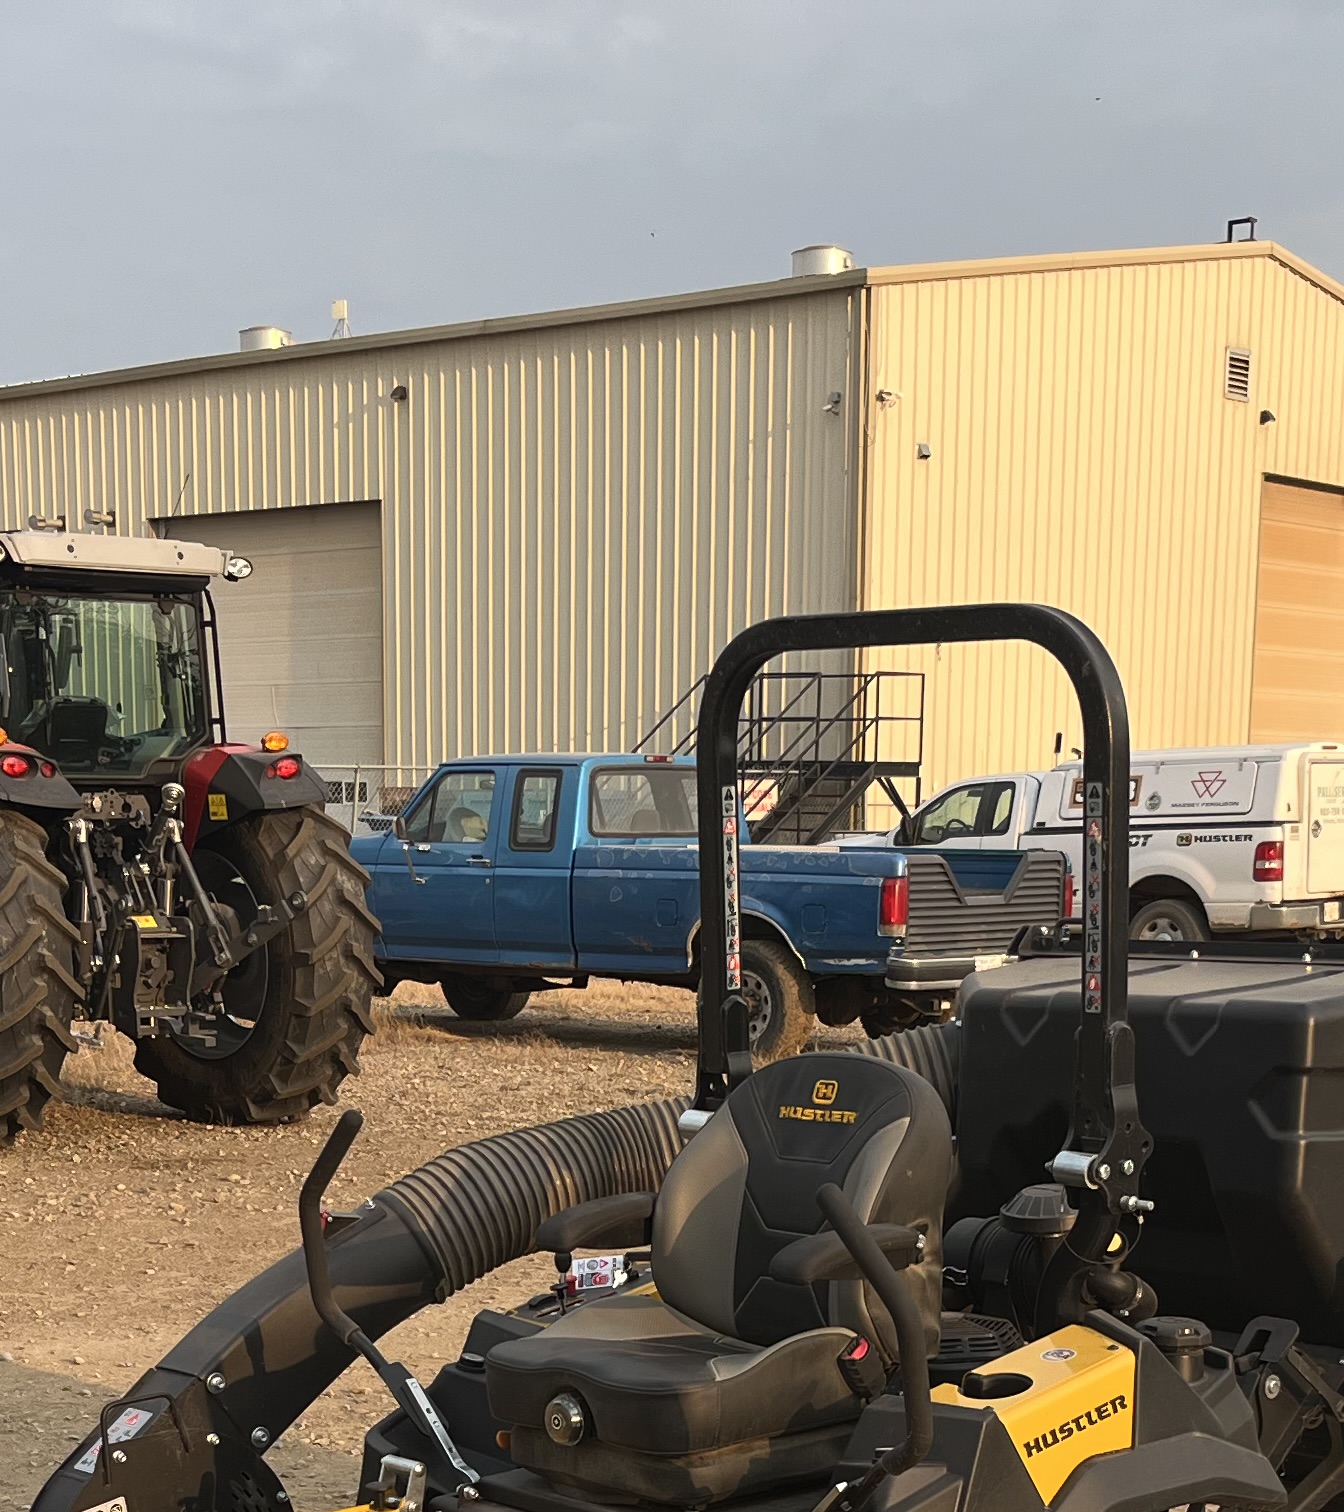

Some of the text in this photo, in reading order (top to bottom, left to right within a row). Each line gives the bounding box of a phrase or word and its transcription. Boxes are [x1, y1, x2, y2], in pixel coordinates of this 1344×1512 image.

[1194, 834, 1253, 843] HUSTLER
[778, 1105, 859, 1124] HUSTLER
[1023, 1394, 1128, 1459] HUSTLER
